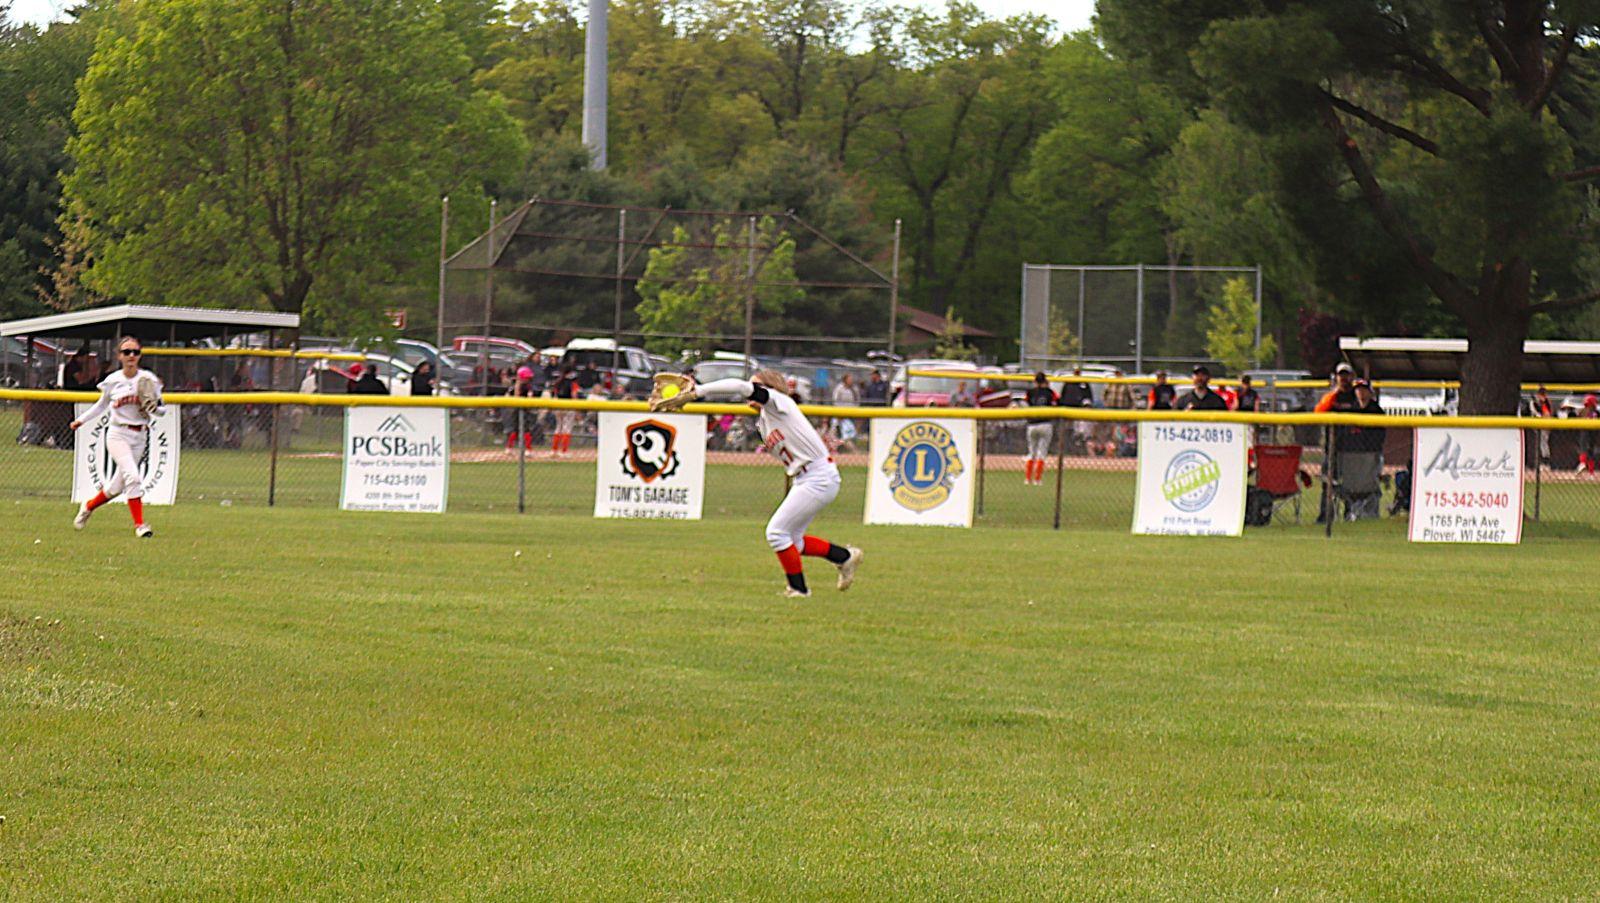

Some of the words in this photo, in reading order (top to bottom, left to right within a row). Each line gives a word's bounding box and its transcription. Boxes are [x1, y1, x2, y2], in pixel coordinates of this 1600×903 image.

[901, 425, 947, 444] LIONS
[1155, 427, 1233, 443] 715-422-0819
[352, 436, 442, 457] PCSBank
[1423, 431, 1515, 481] Mark
[87, 442, 104, 491] ENECA
[913, 449, 936, 482] L
[609, 485, 641, 502] TOM'S
[643, 487, 689, 504] GARAGE
[1425, 489, 1509, 508] 715-342-5040
[1430, 515, 1452, 527] 1765
[1455, 515, 1477, 527] Park
[1480, 516, 1500, 528] Ave
[1460, 529, 1473, 541] WI
[1476, 529, 1506, 542] 54467
